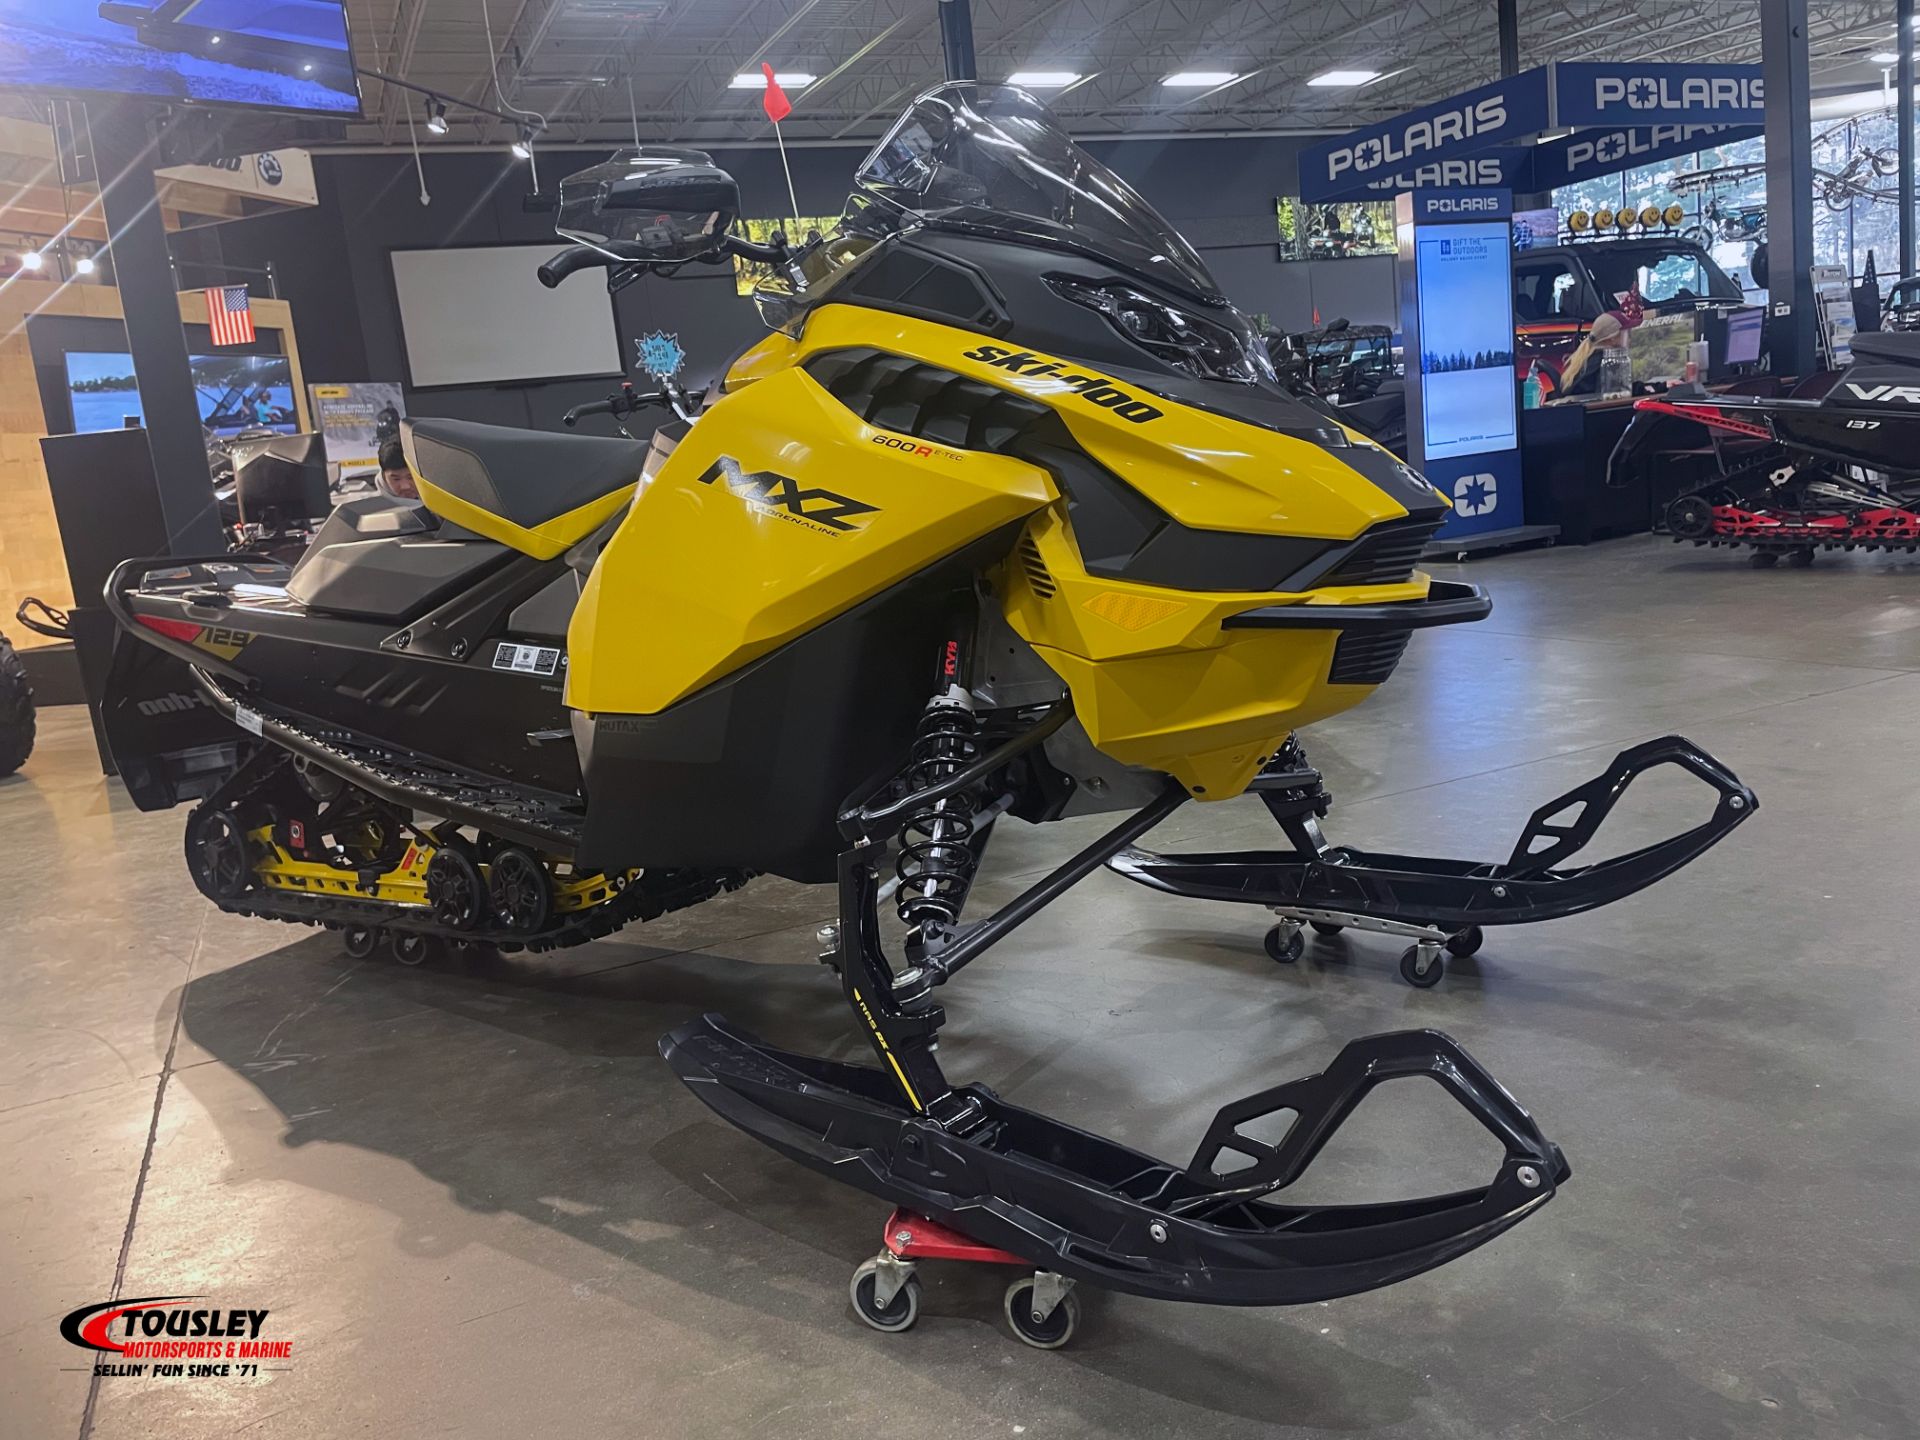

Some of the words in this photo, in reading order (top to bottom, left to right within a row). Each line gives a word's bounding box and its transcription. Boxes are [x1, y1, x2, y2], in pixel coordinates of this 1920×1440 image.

[1328, 95, 1507, 181] POLARIS
[1427, 197, 1499, 213] POLARIS
[1452, 238, 1467, 247] GIFT
[1469, 237, 1481, 246] THE
[1453, 245, 1488, 255] OUTDOORS
[1640, 314, 1684, 328] ENERAL
[962, 345, 1165, 424] ski-doo
[1846, 419, 1881, 430] 137
[934, 449, 964, 461] E-TEC
[697, 454, 882, 531] MXZ
[755, 505, 841, 538] ADRENALINE
[205, 627, 250, 648] 129
[944, 640, 958, 675] KYB
